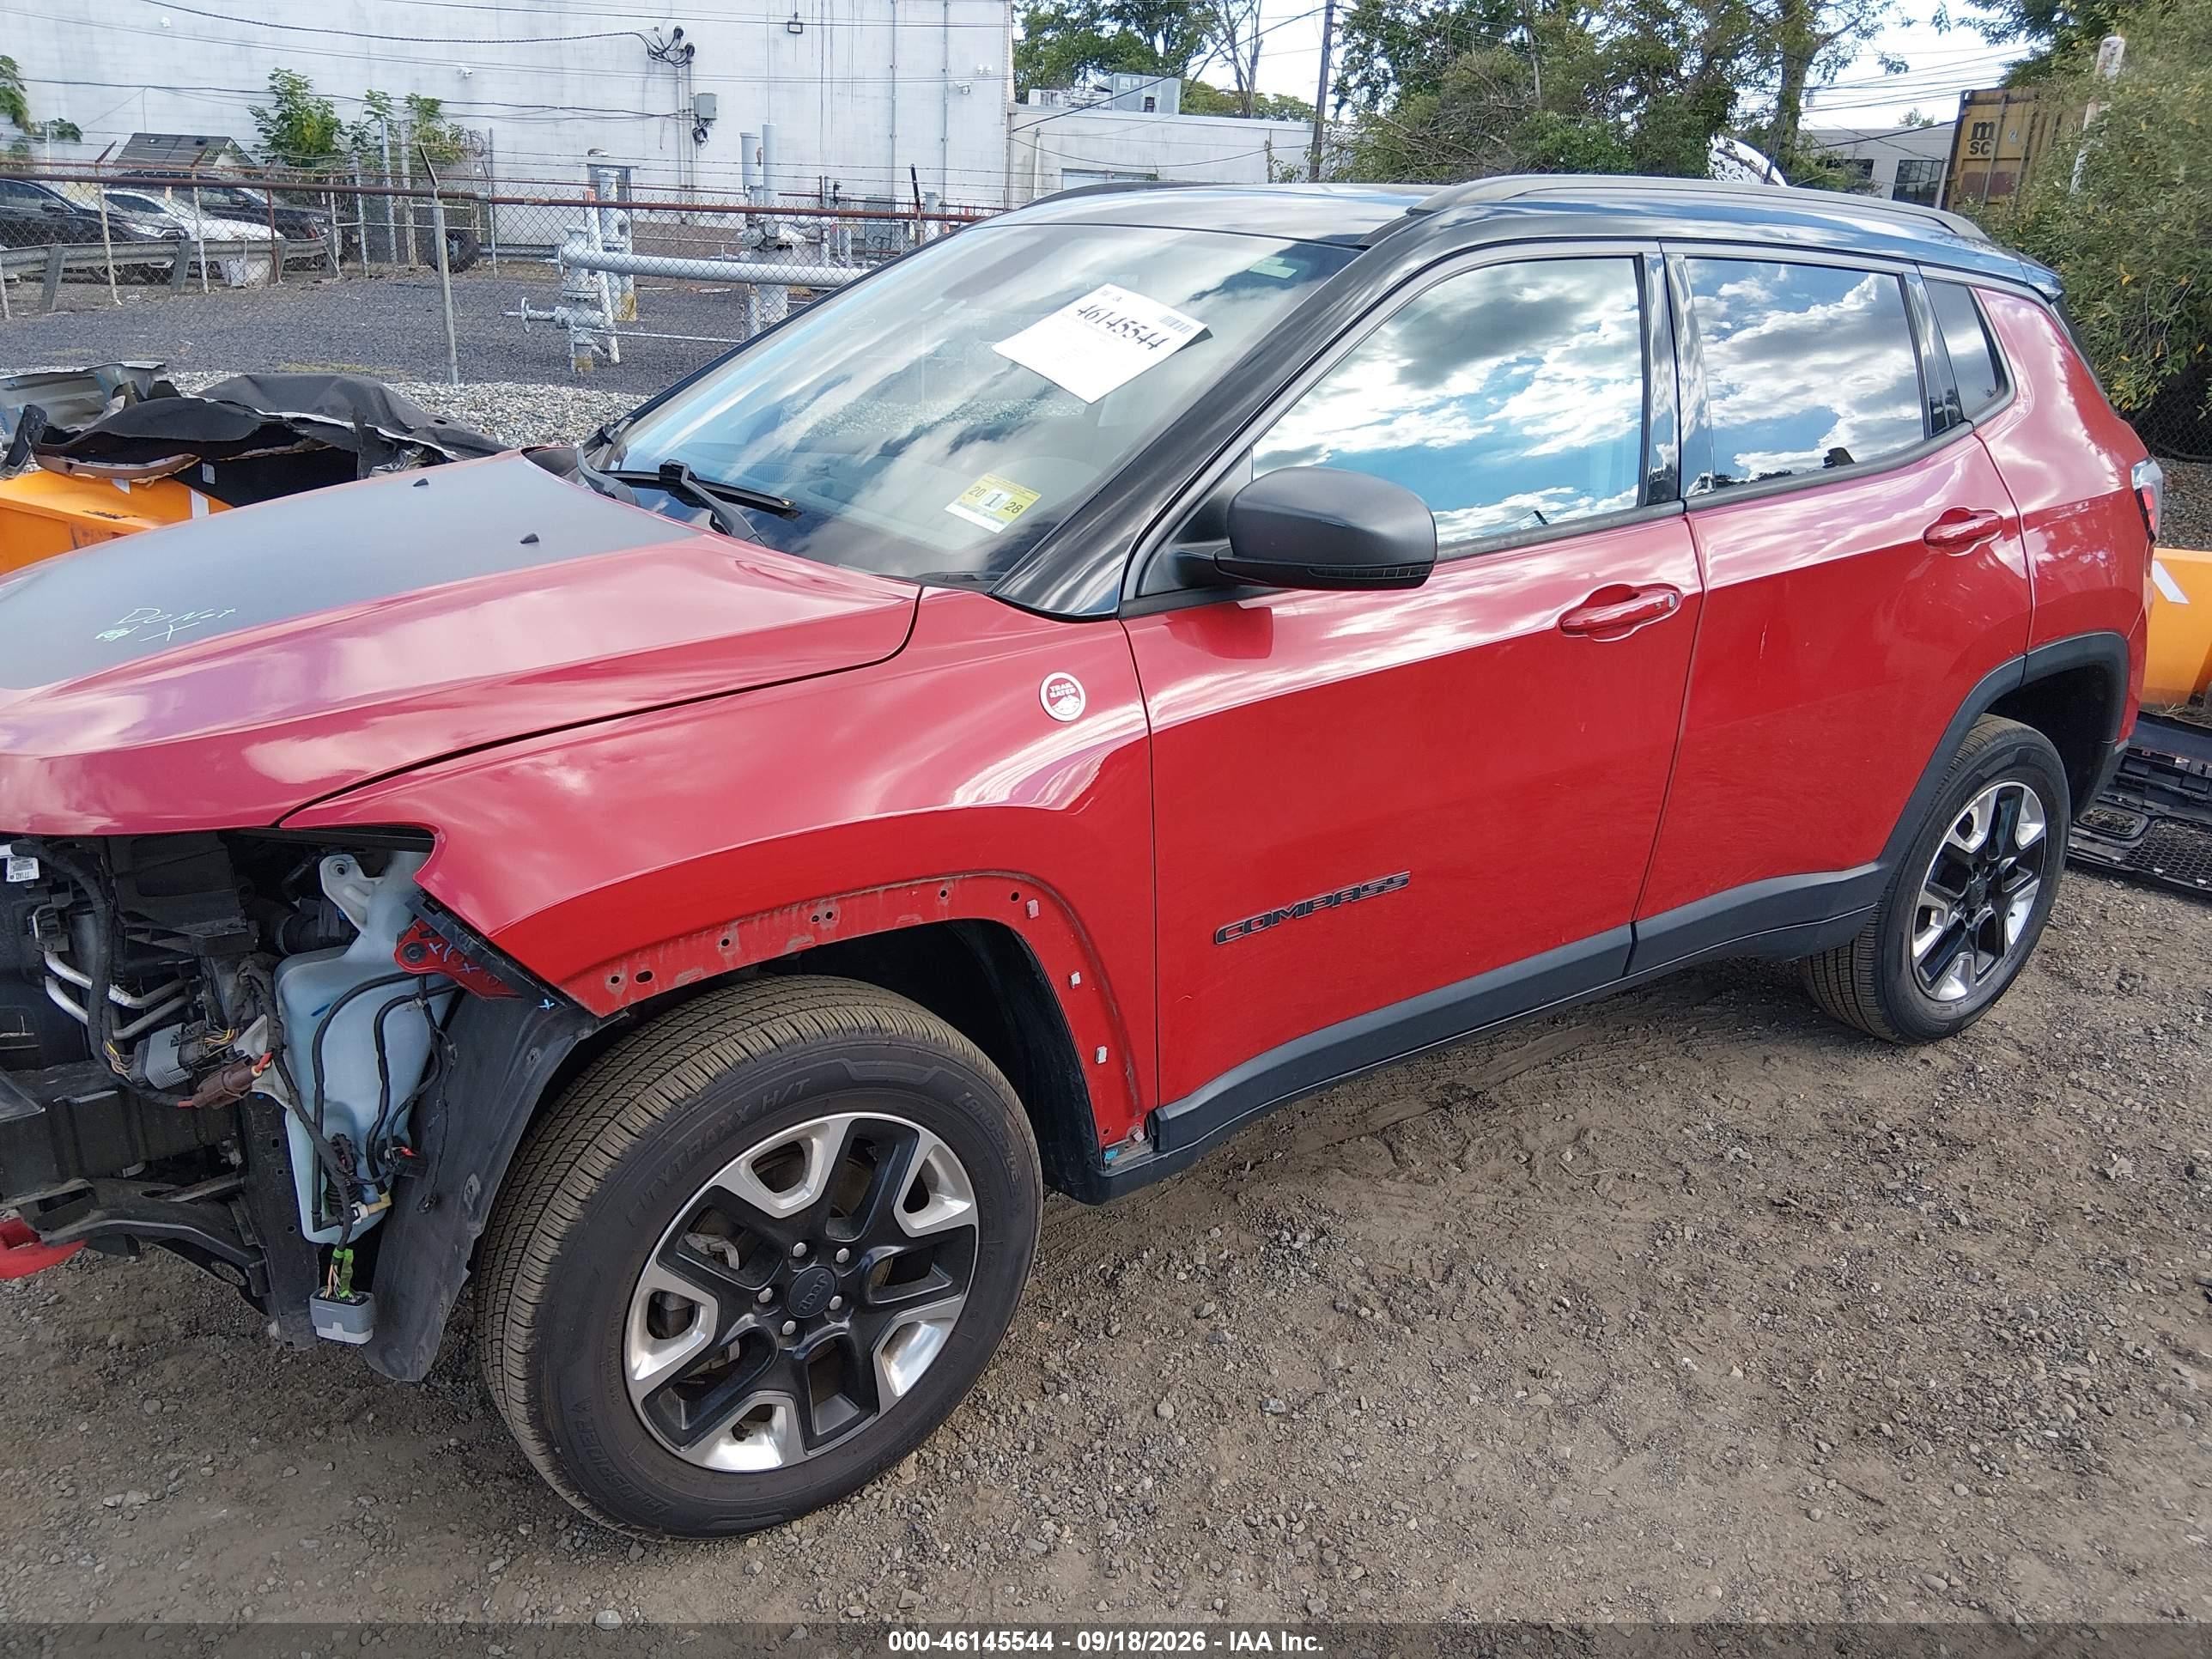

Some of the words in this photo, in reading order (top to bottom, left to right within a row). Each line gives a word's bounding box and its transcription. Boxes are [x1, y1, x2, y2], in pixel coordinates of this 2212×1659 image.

[1076, 304, 1170, 350] 46145544
[967, 485, 987, 498] 20
[984, 492, 1004, 508] 1
[1003, 501, 1024, 514] 28
[1213, 870, 1412, 945] COMPASS
[761, 1077, 811, 1113] H/T
[798, 1273, 828, 1311] Jeep
